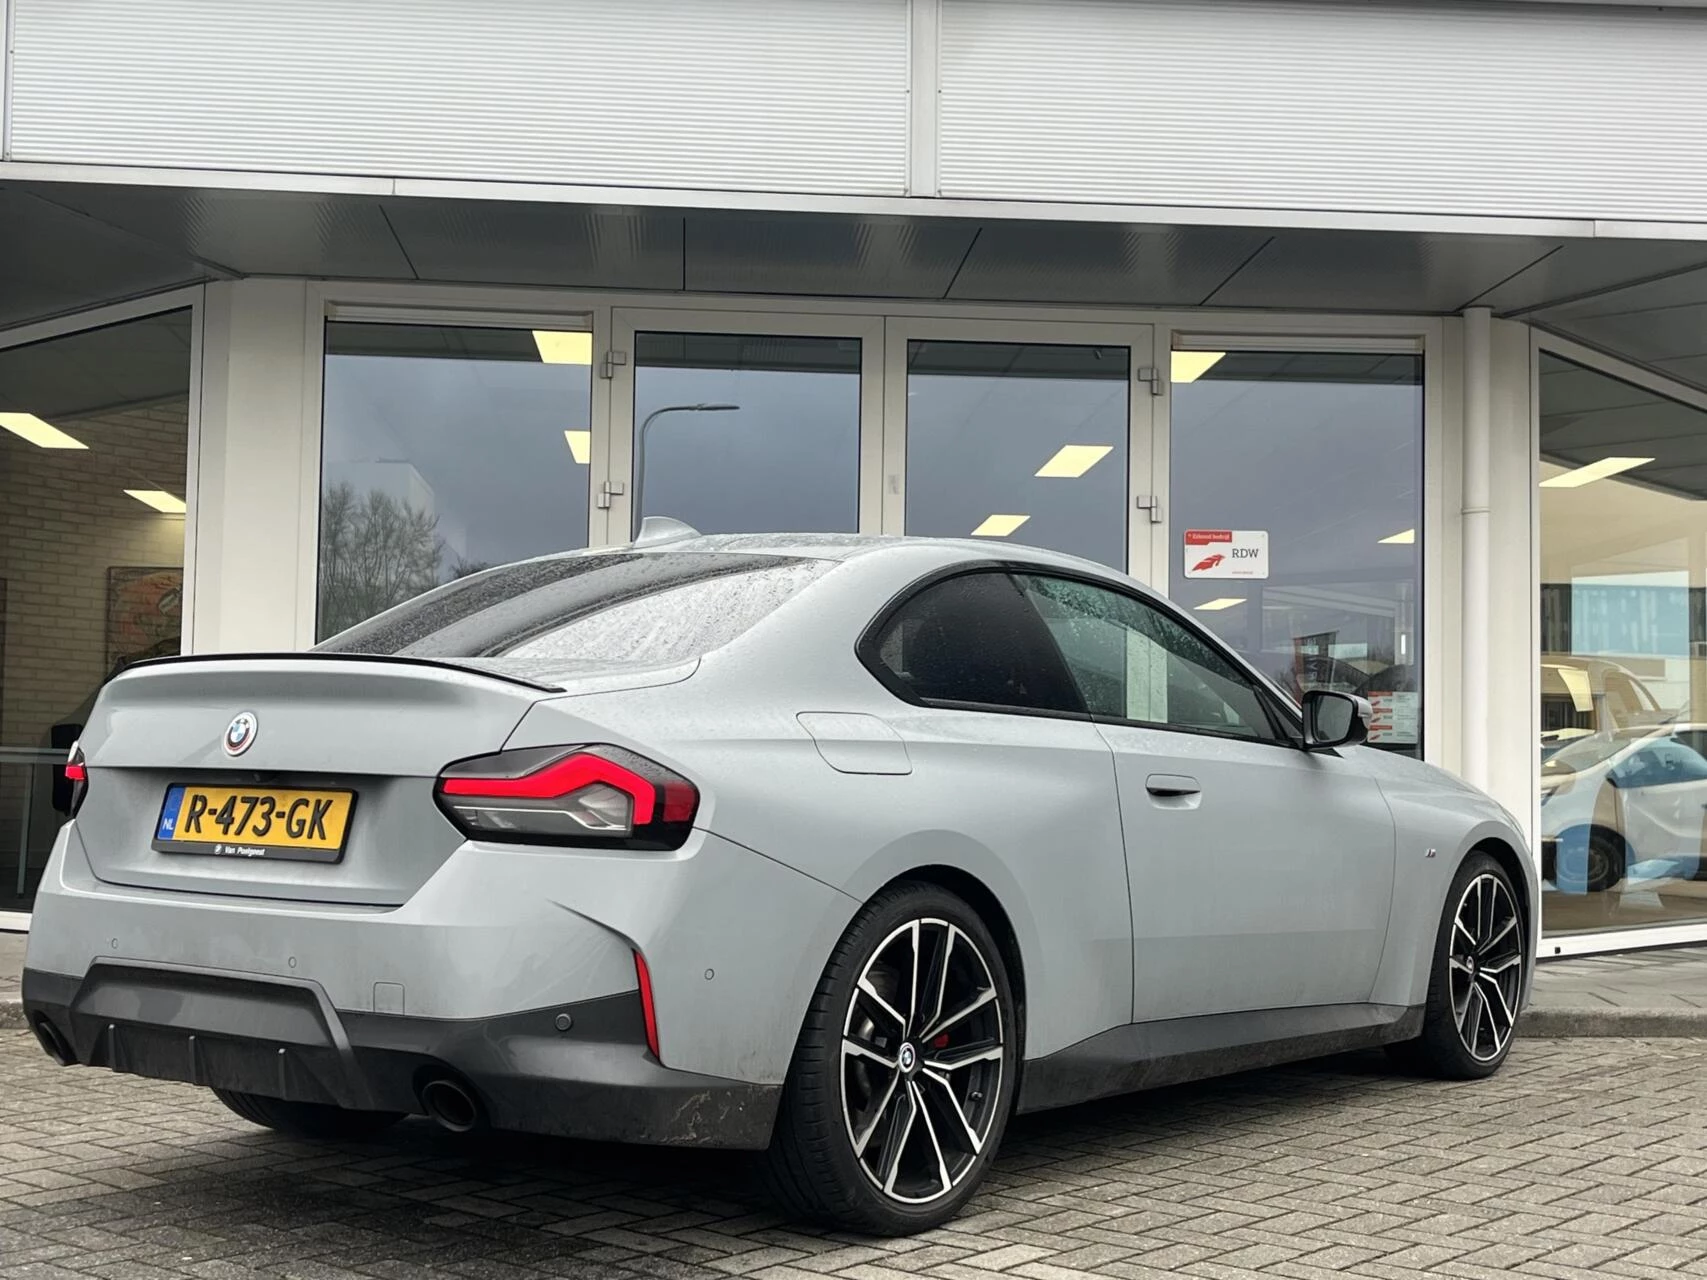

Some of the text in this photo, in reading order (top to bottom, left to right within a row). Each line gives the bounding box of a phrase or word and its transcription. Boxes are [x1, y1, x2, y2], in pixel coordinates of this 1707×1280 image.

[1232, 548, 1259, 558] RDW
[184, 794, 333, 840] R-473-GK
[162, 819, 174, 831] NL
